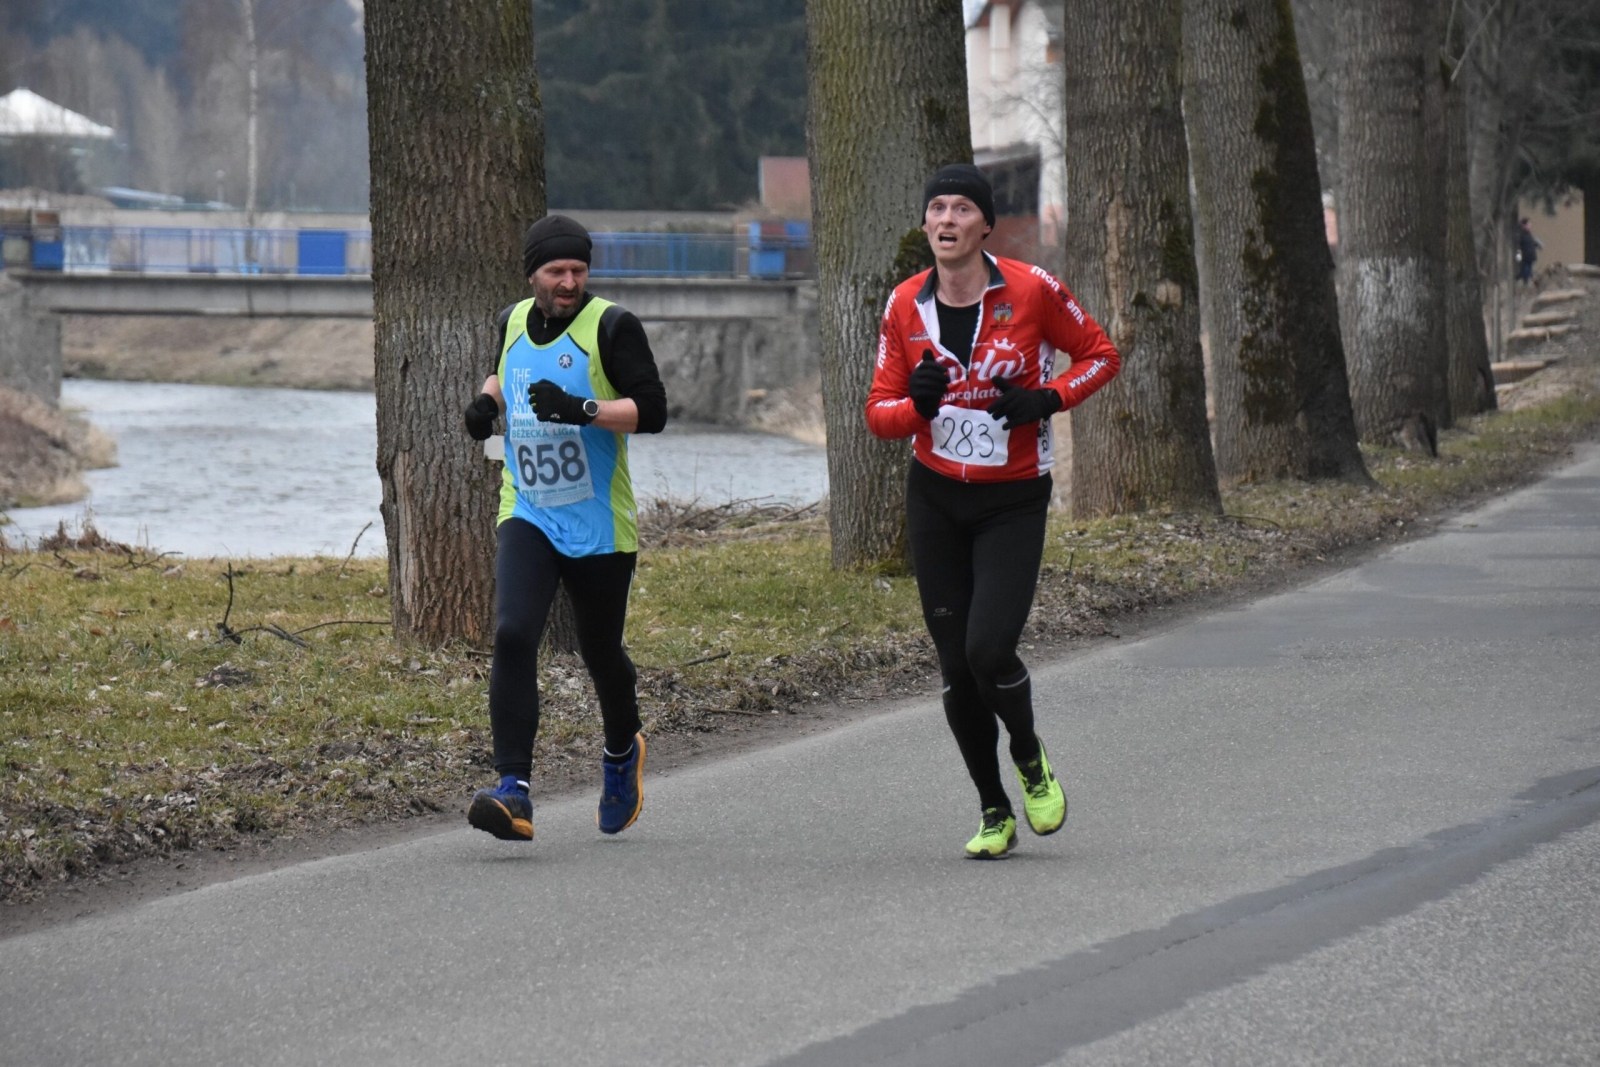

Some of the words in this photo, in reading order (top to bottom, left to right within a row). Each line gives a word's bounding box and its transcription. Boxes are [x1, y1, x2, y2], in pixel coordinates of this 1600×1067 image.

[512, 368, 531, 383] THE
[512, 417, 535, 427] ZIMNÍ
[512, 427, 549, 438] BĚŽECKÁ
[553, 427, 576, 437] LIGA
[940, 416, 995, 459] 283
[518, 440, 585, 487] 658
